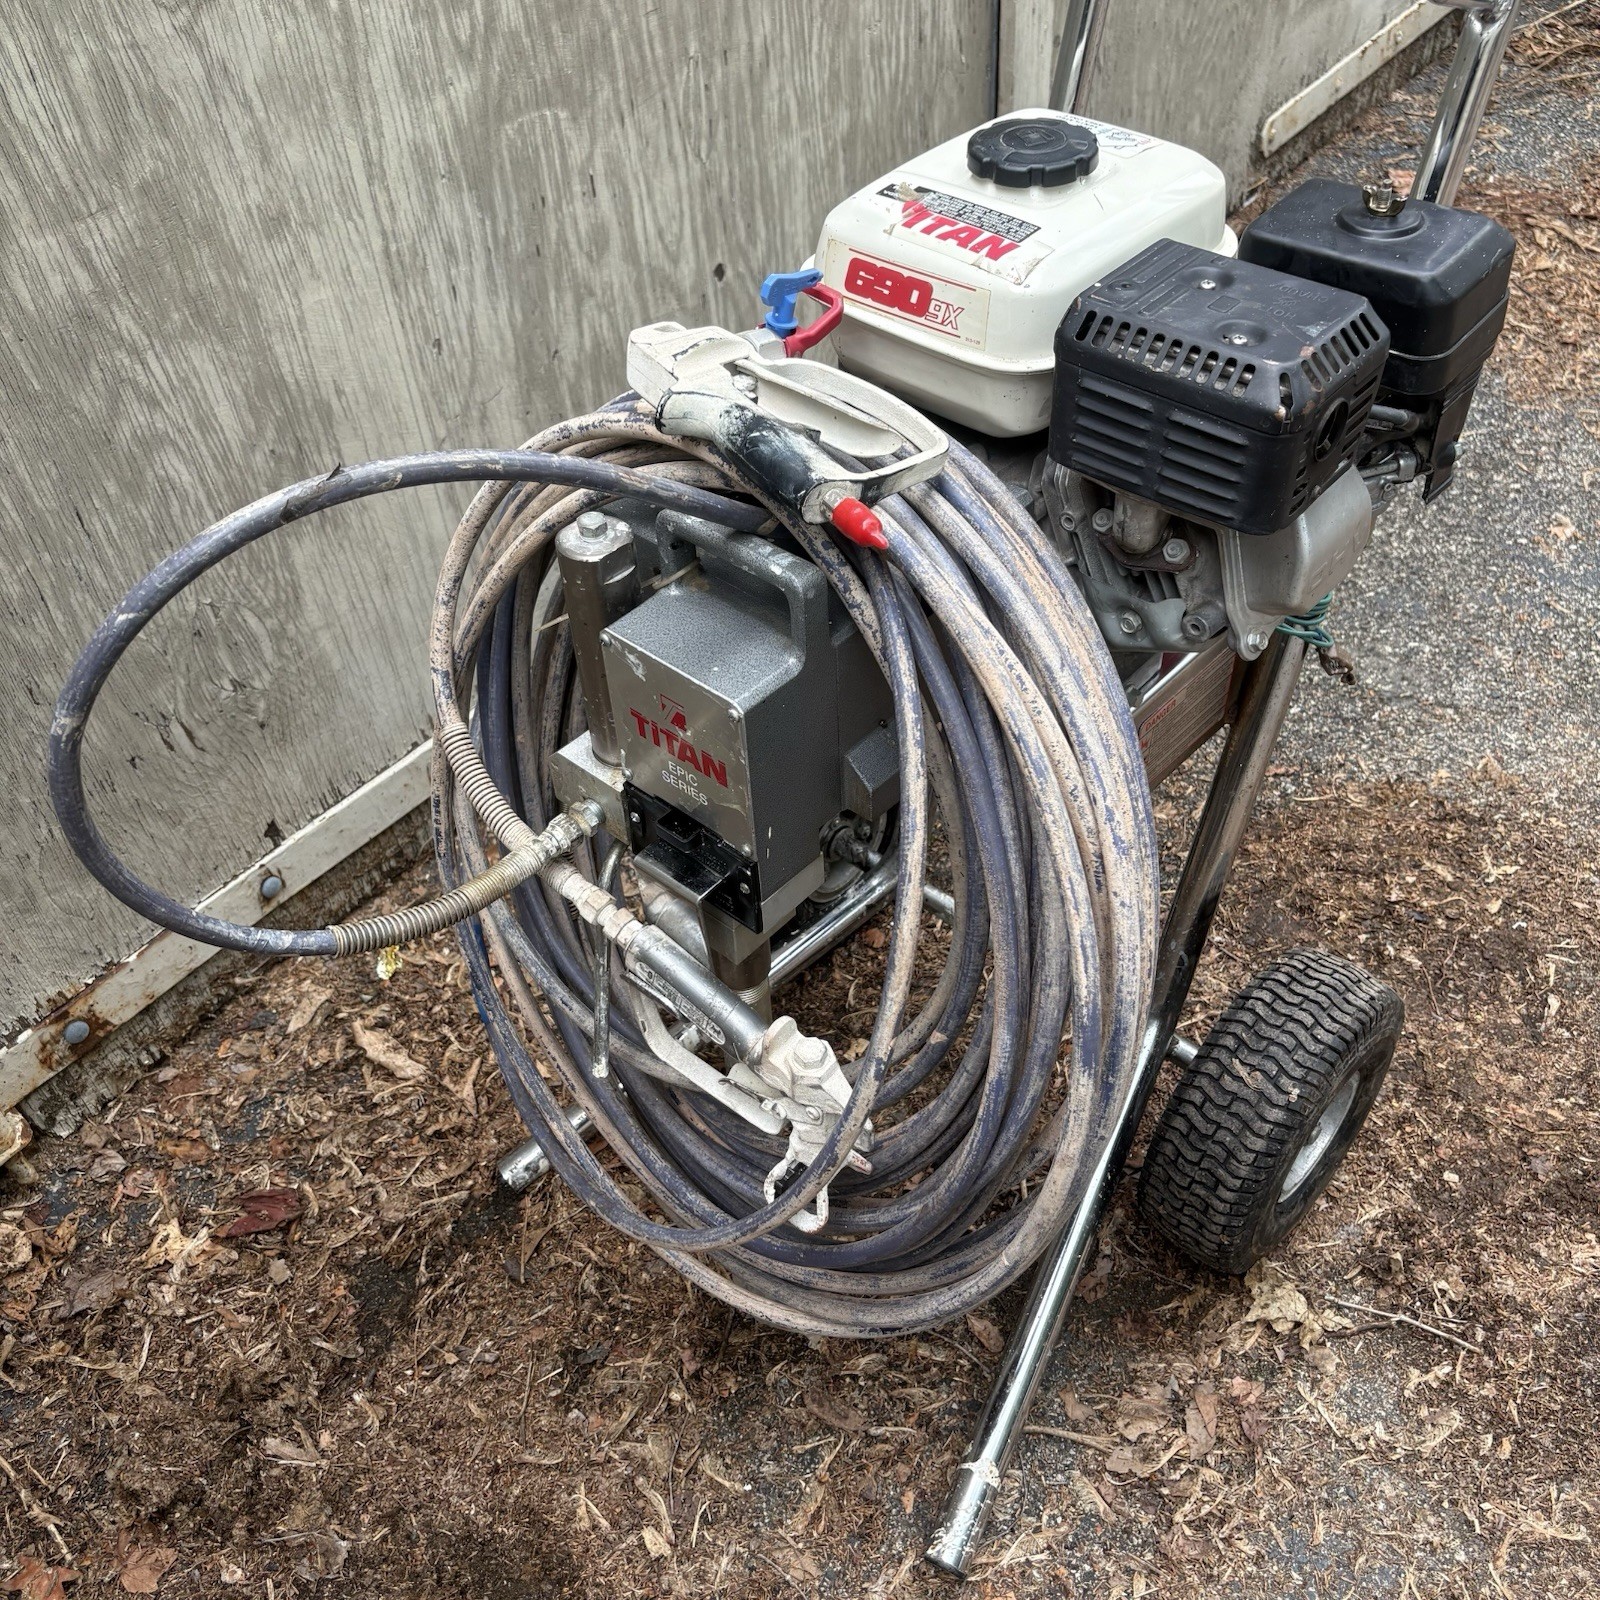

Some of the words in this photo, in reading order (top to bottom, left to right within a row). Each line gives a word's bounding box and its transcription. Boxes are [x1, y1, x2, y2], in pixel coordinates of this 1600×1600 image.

[845, 257, 933, 318] 690
[1145, 700, 1176, 732] DANGER
[661, 769, 708, 805] SERIES
[668, 760, 698, 787] EPIC
